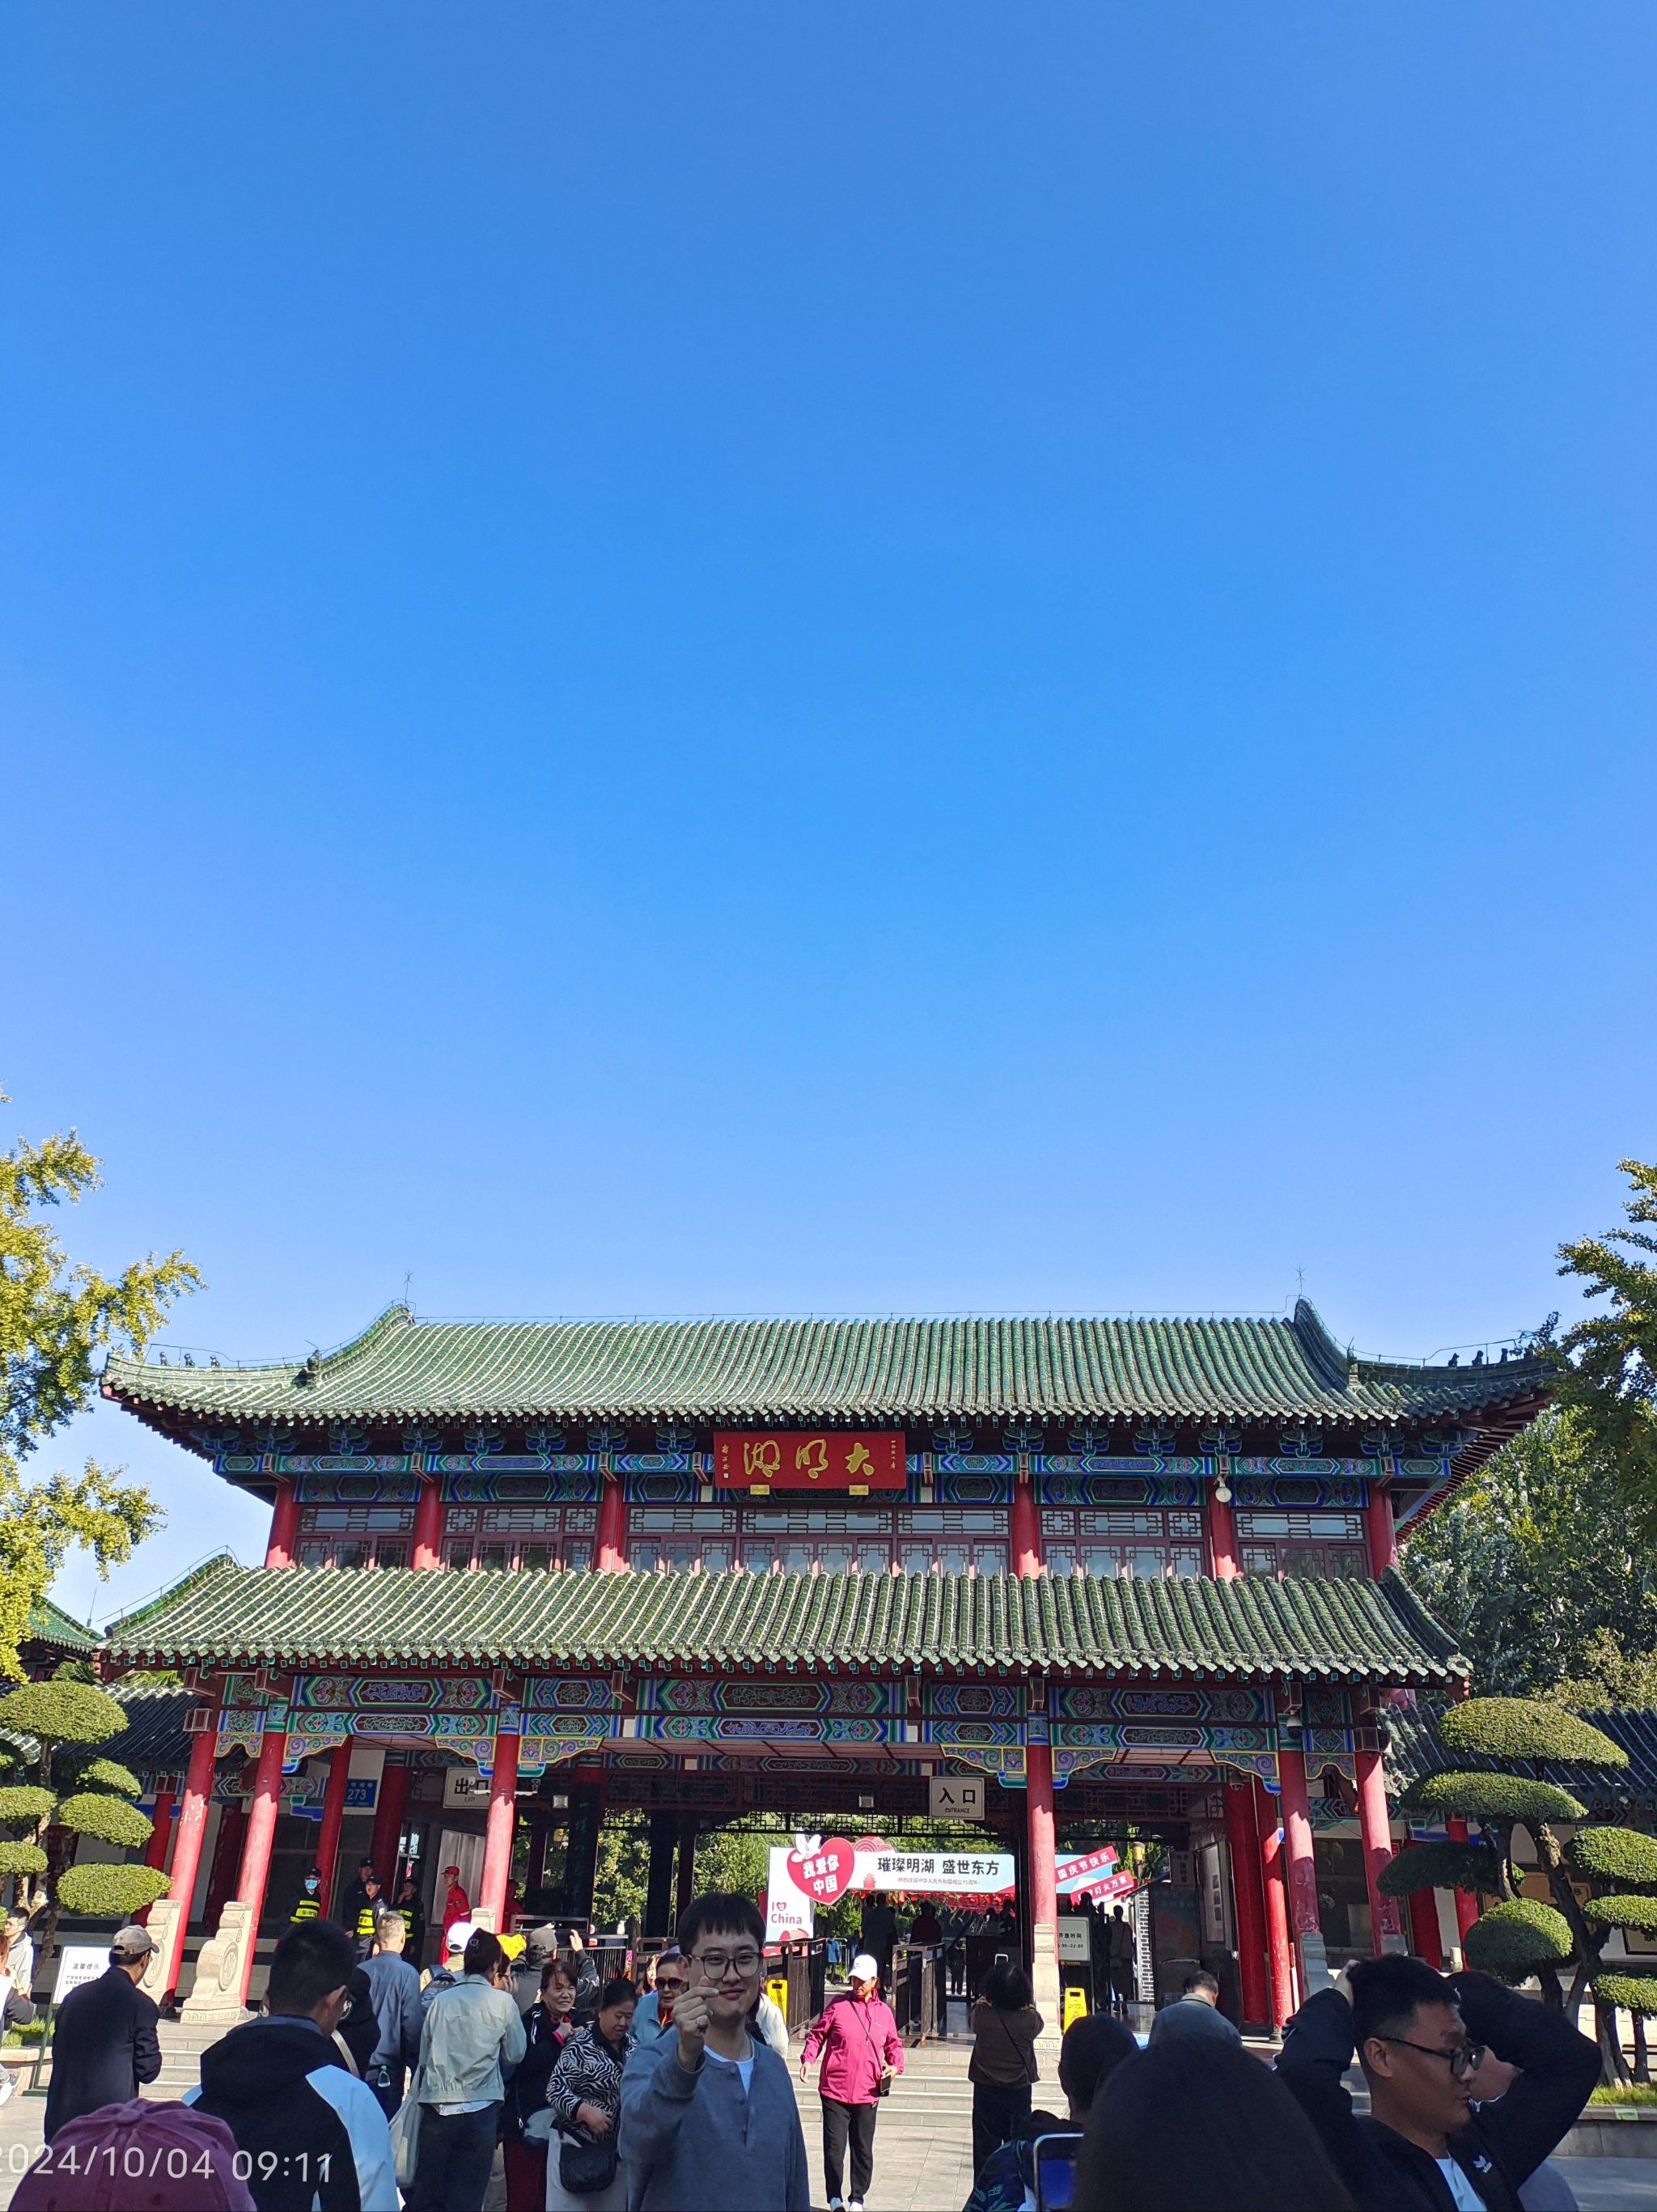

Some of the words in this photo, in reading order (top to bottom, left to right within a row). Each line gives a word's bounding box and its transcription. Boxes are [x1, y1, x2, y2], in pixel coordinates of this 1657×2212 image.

[346, 1789, 367, 1800] 273
[455, 1777, 489, 1795] 出口
[939, 1787, 976, 1804] 入口
[803, 1854, 840, 1879] 我爱你
[877, 1857, 934, 1874] 璀璨明湖
[942, 1859, 999, 1875] 盛世东方
[1057, 1852, 1109, 1879] 国庆节快乐
[813, 1874, 838, 1896] 中国
[771, 1913, 803, 1924] China
